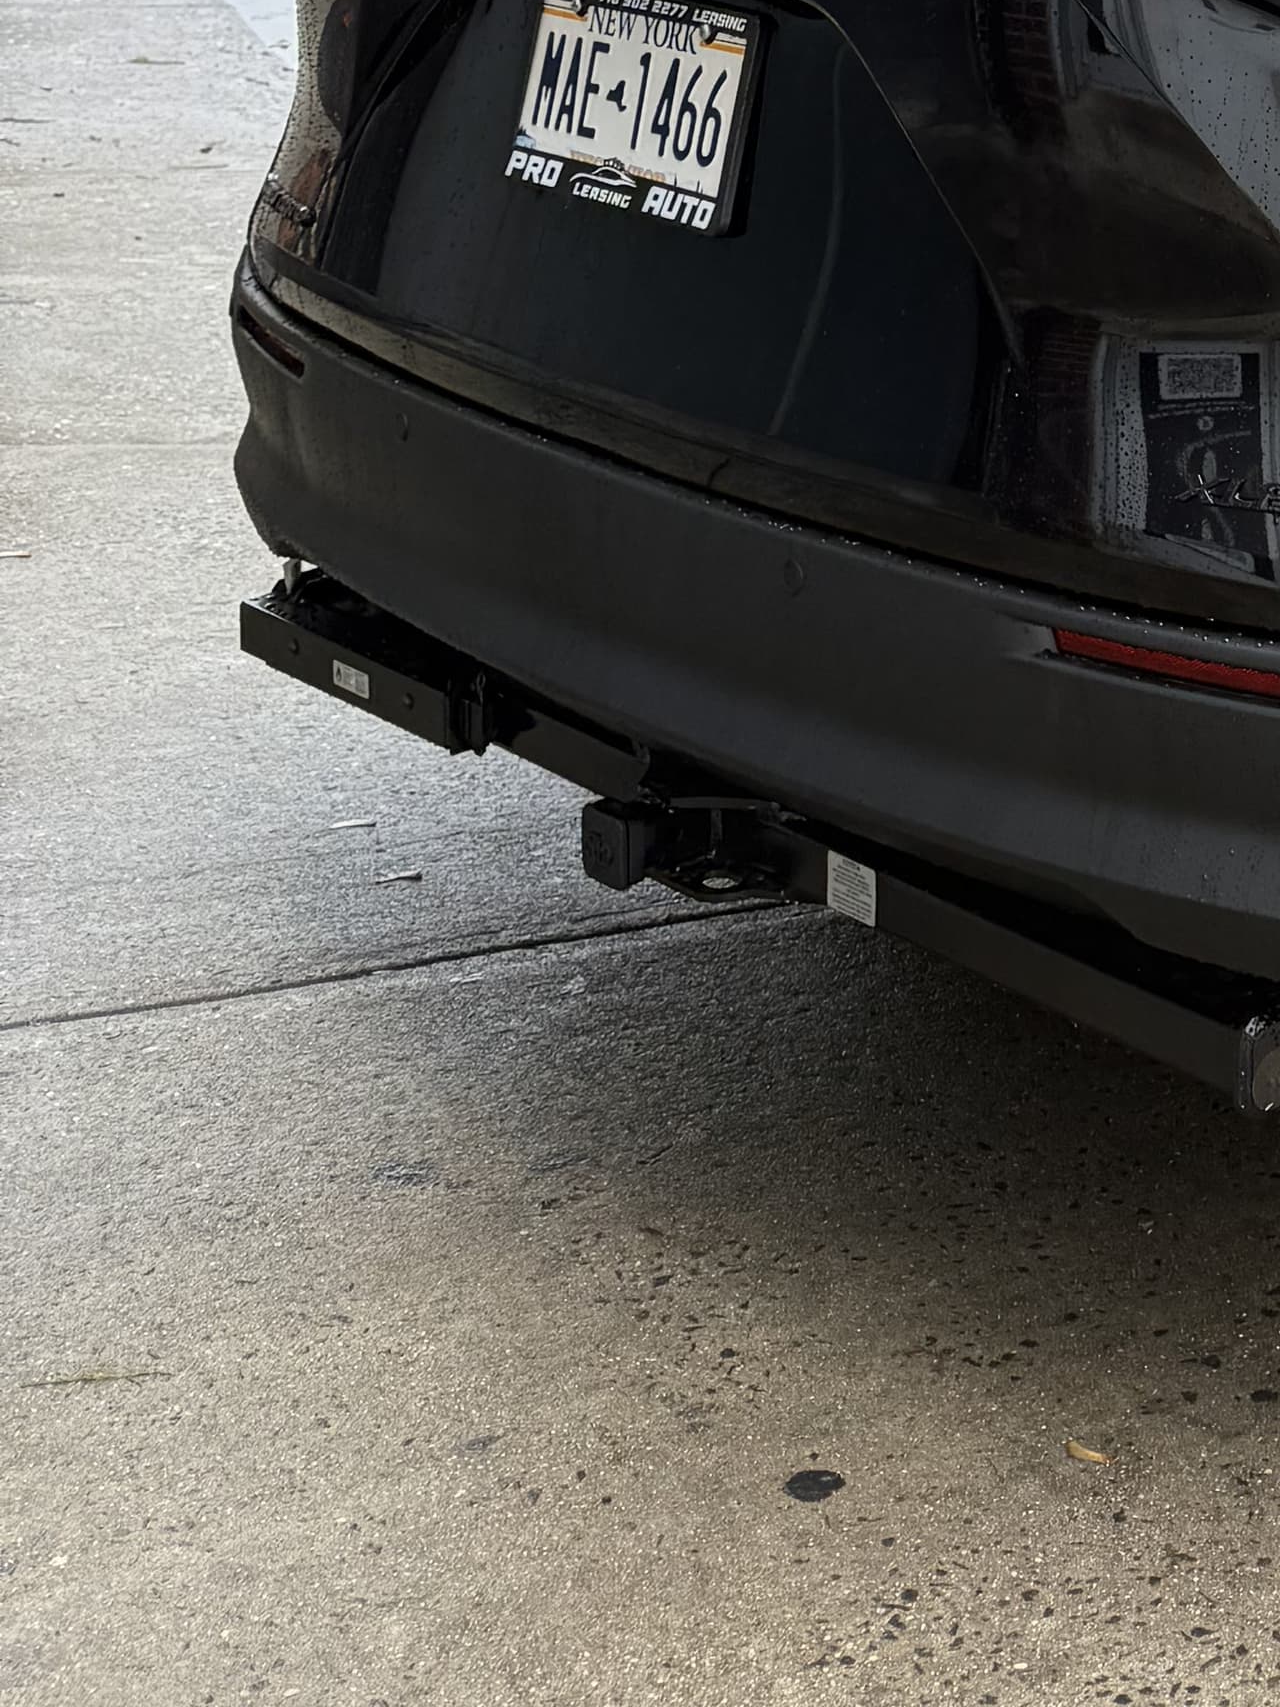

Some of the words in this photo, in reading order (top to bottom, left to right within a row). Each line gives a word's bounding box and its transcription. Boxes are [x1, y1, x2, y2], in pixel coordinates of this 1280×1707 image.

[588, 5, 636, 42] NEW
[641, 15, 698, 55] YORK
[651, 0, 689, 19] 2277
[692, 8, 747, 32] LEASING
[531, 32, 610, 139] MAE
[630, 52, 728, 168] 1466
[505, 150, 564, 189] PRO
[641, 185, 717, 231] AUTO
[572, 182, 632, 209] LEASING
